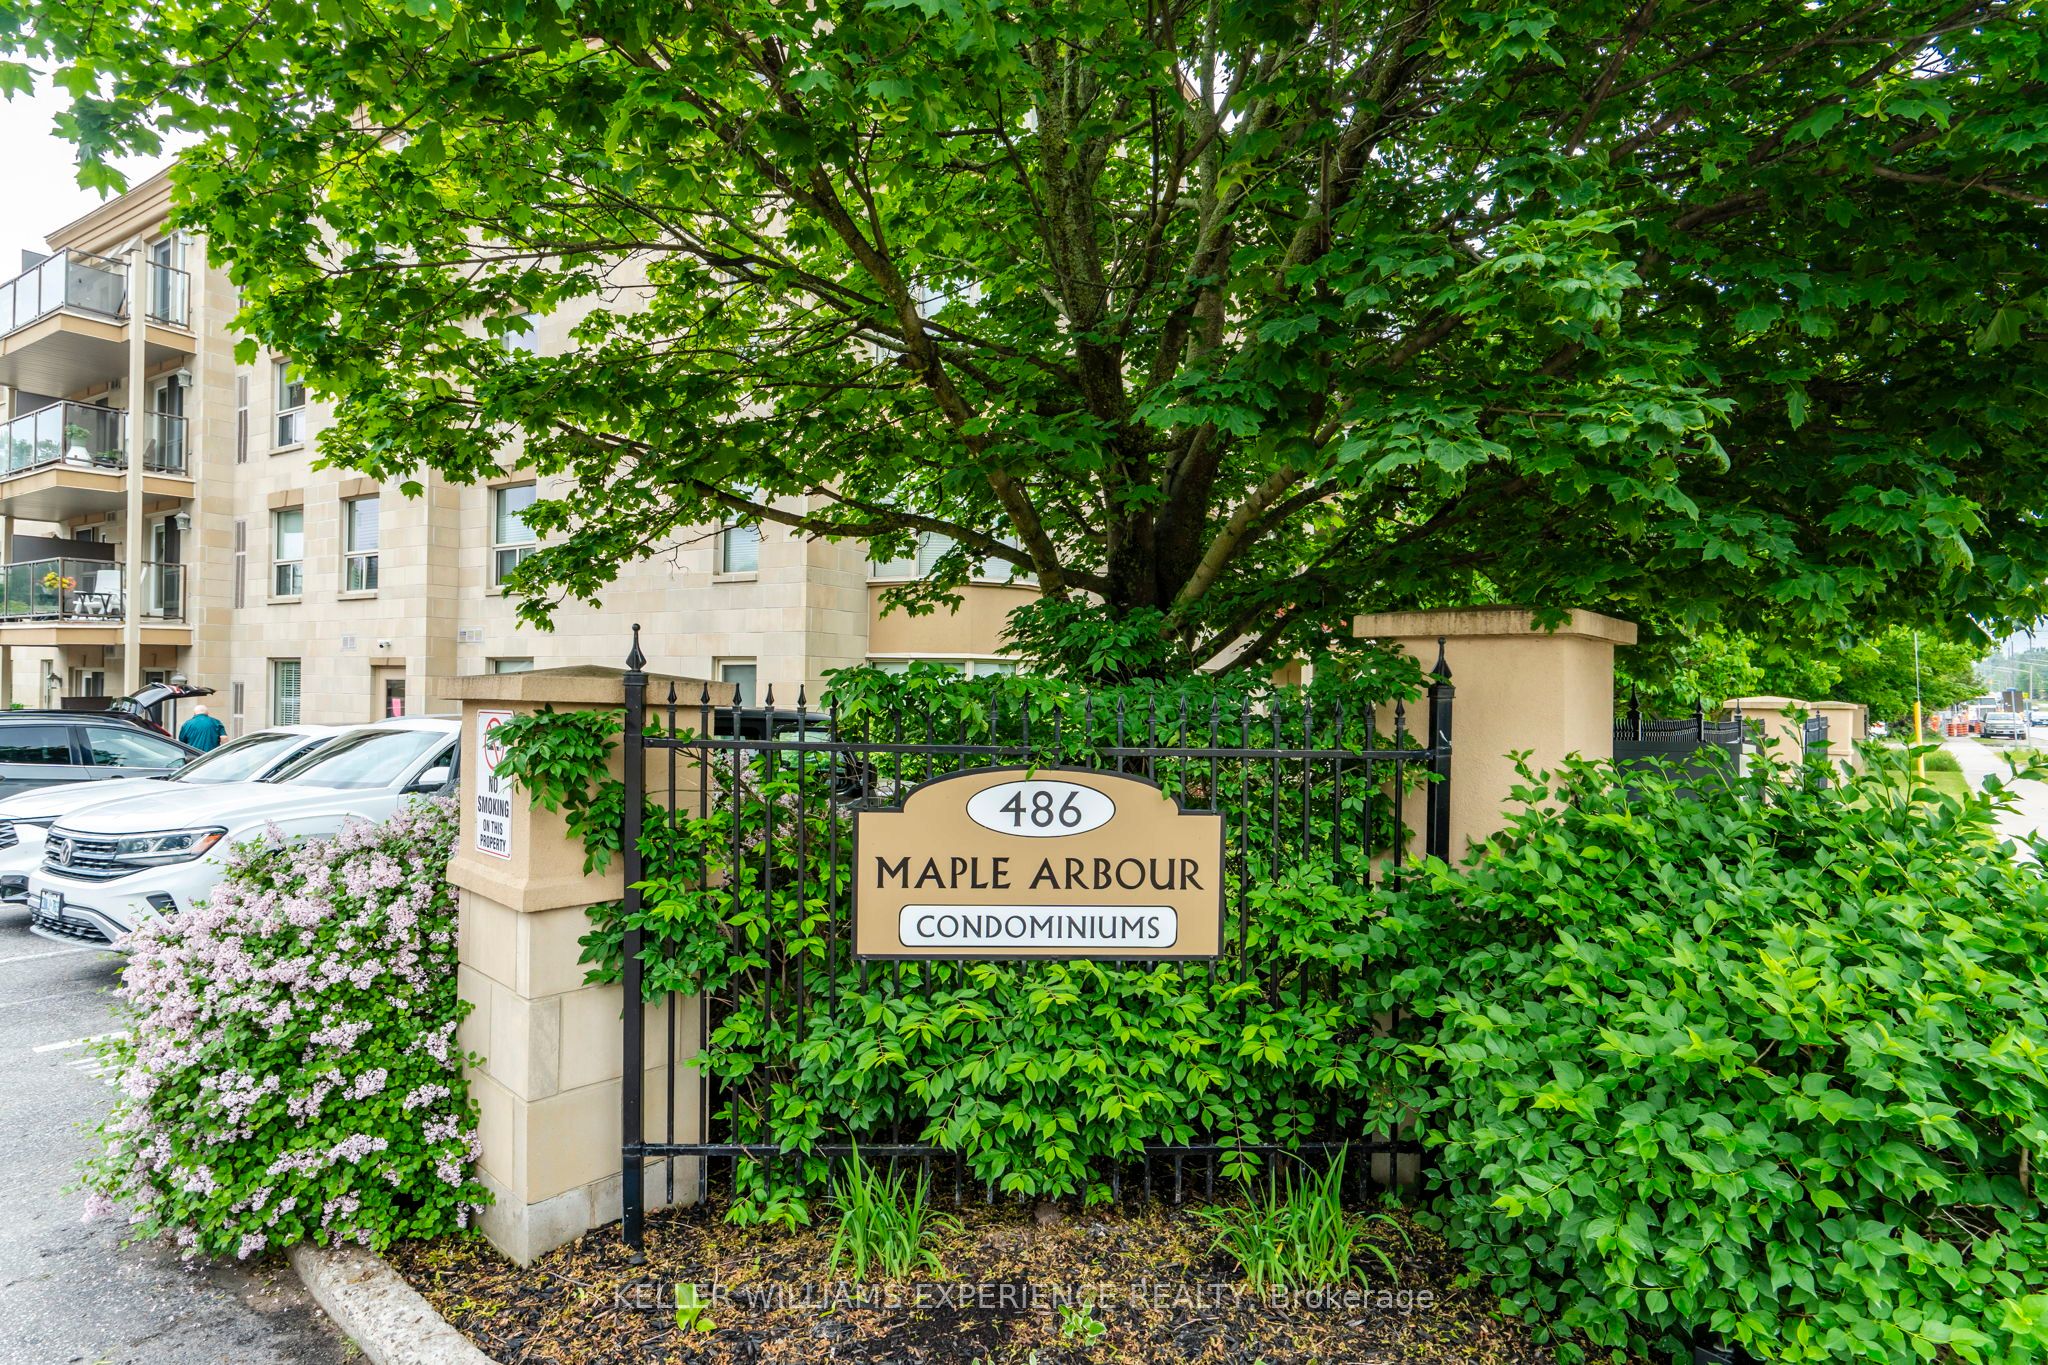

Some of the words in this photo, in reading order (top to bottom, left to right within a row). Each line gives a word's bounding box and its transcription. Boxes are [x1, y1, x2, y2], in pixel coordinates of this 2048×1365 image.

[488, 775, 498, 793] NO
[477, 795, 509, 817] SMOKING
[1000, 791, 1082, 827] 486
[482, 819, 490, 832] ON
[491, 821, 503, 835] THIS
[479, 834, 506, 852] PROPERTY
[876, 856, 1011, 889] MAPLE
[1028, 857, 1205, 890] ARBOUR
[916, 914, 1161, 939] CONDOMINIUMS
